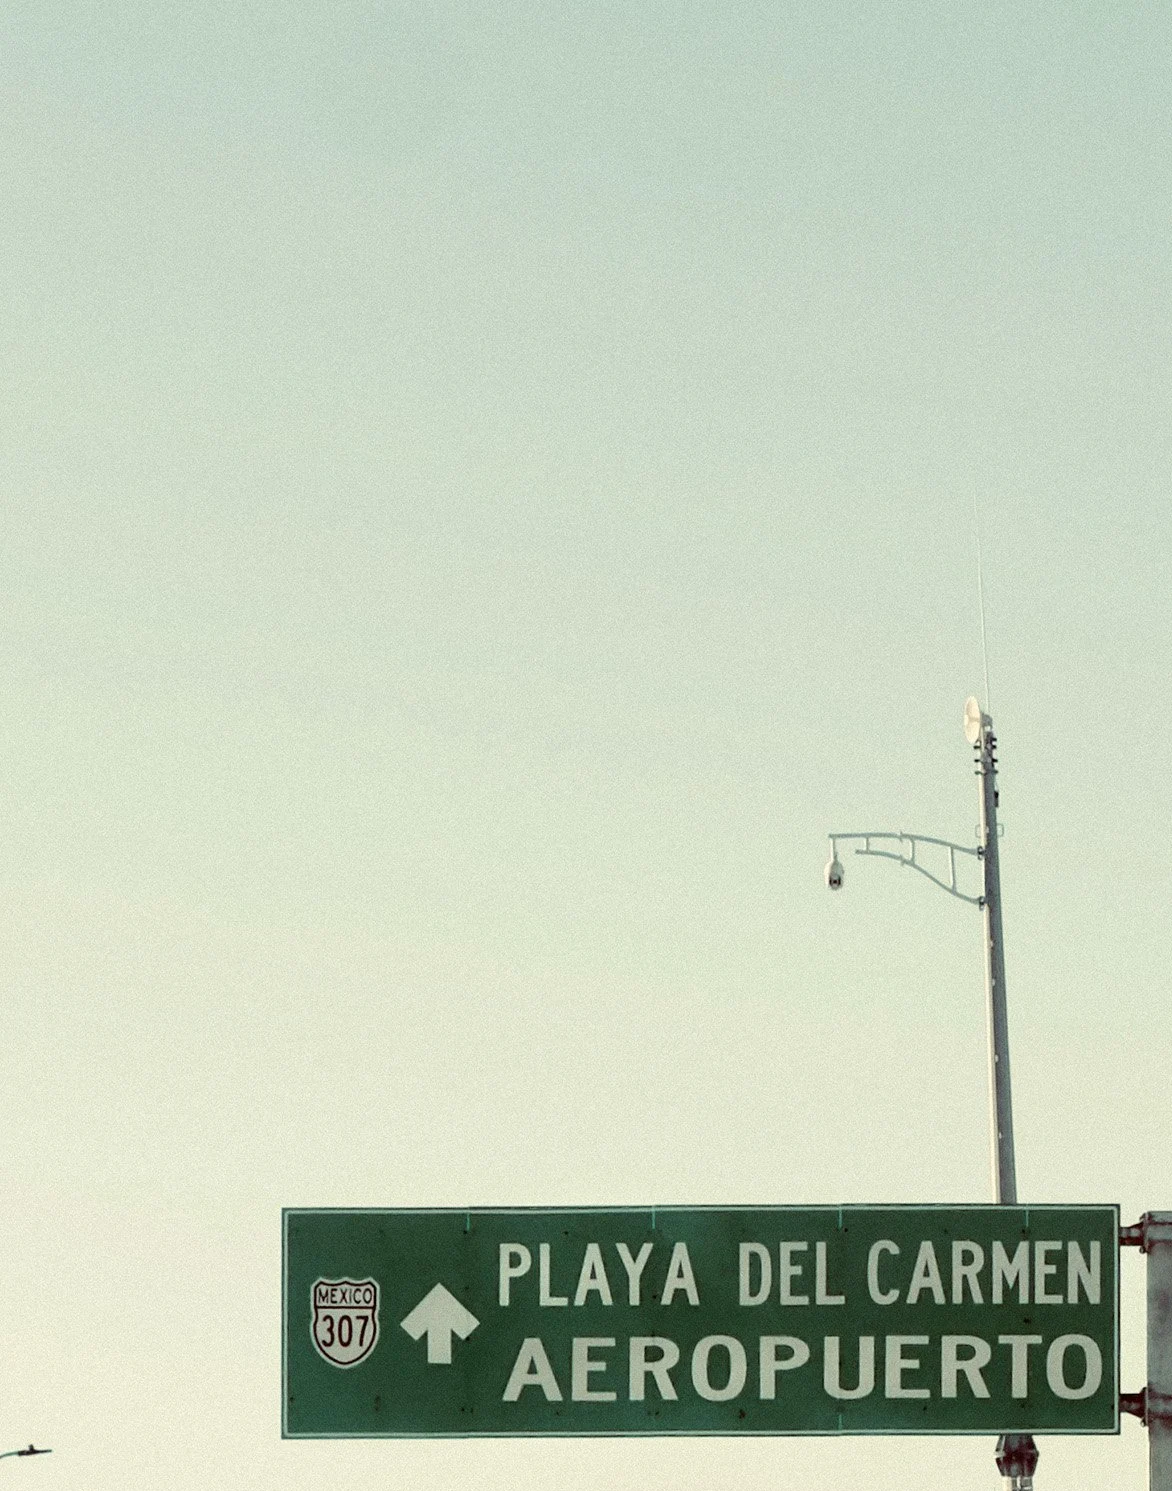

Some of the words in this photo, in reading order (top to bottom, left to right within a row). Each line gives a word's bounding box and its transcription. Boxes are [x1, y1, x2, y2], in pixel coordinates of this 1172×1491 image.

[318, 1288, 373, 1305] MEXICO
[499, 1242, 700, 1306] PLAYA
[739, 1242, 845, 1306] DEL
[867, 1239, 1101, 1305] CARMEN
[321, 1314, 369, 1348] 307
[502, 1333, 1102, 1402] AEROPUERTO
